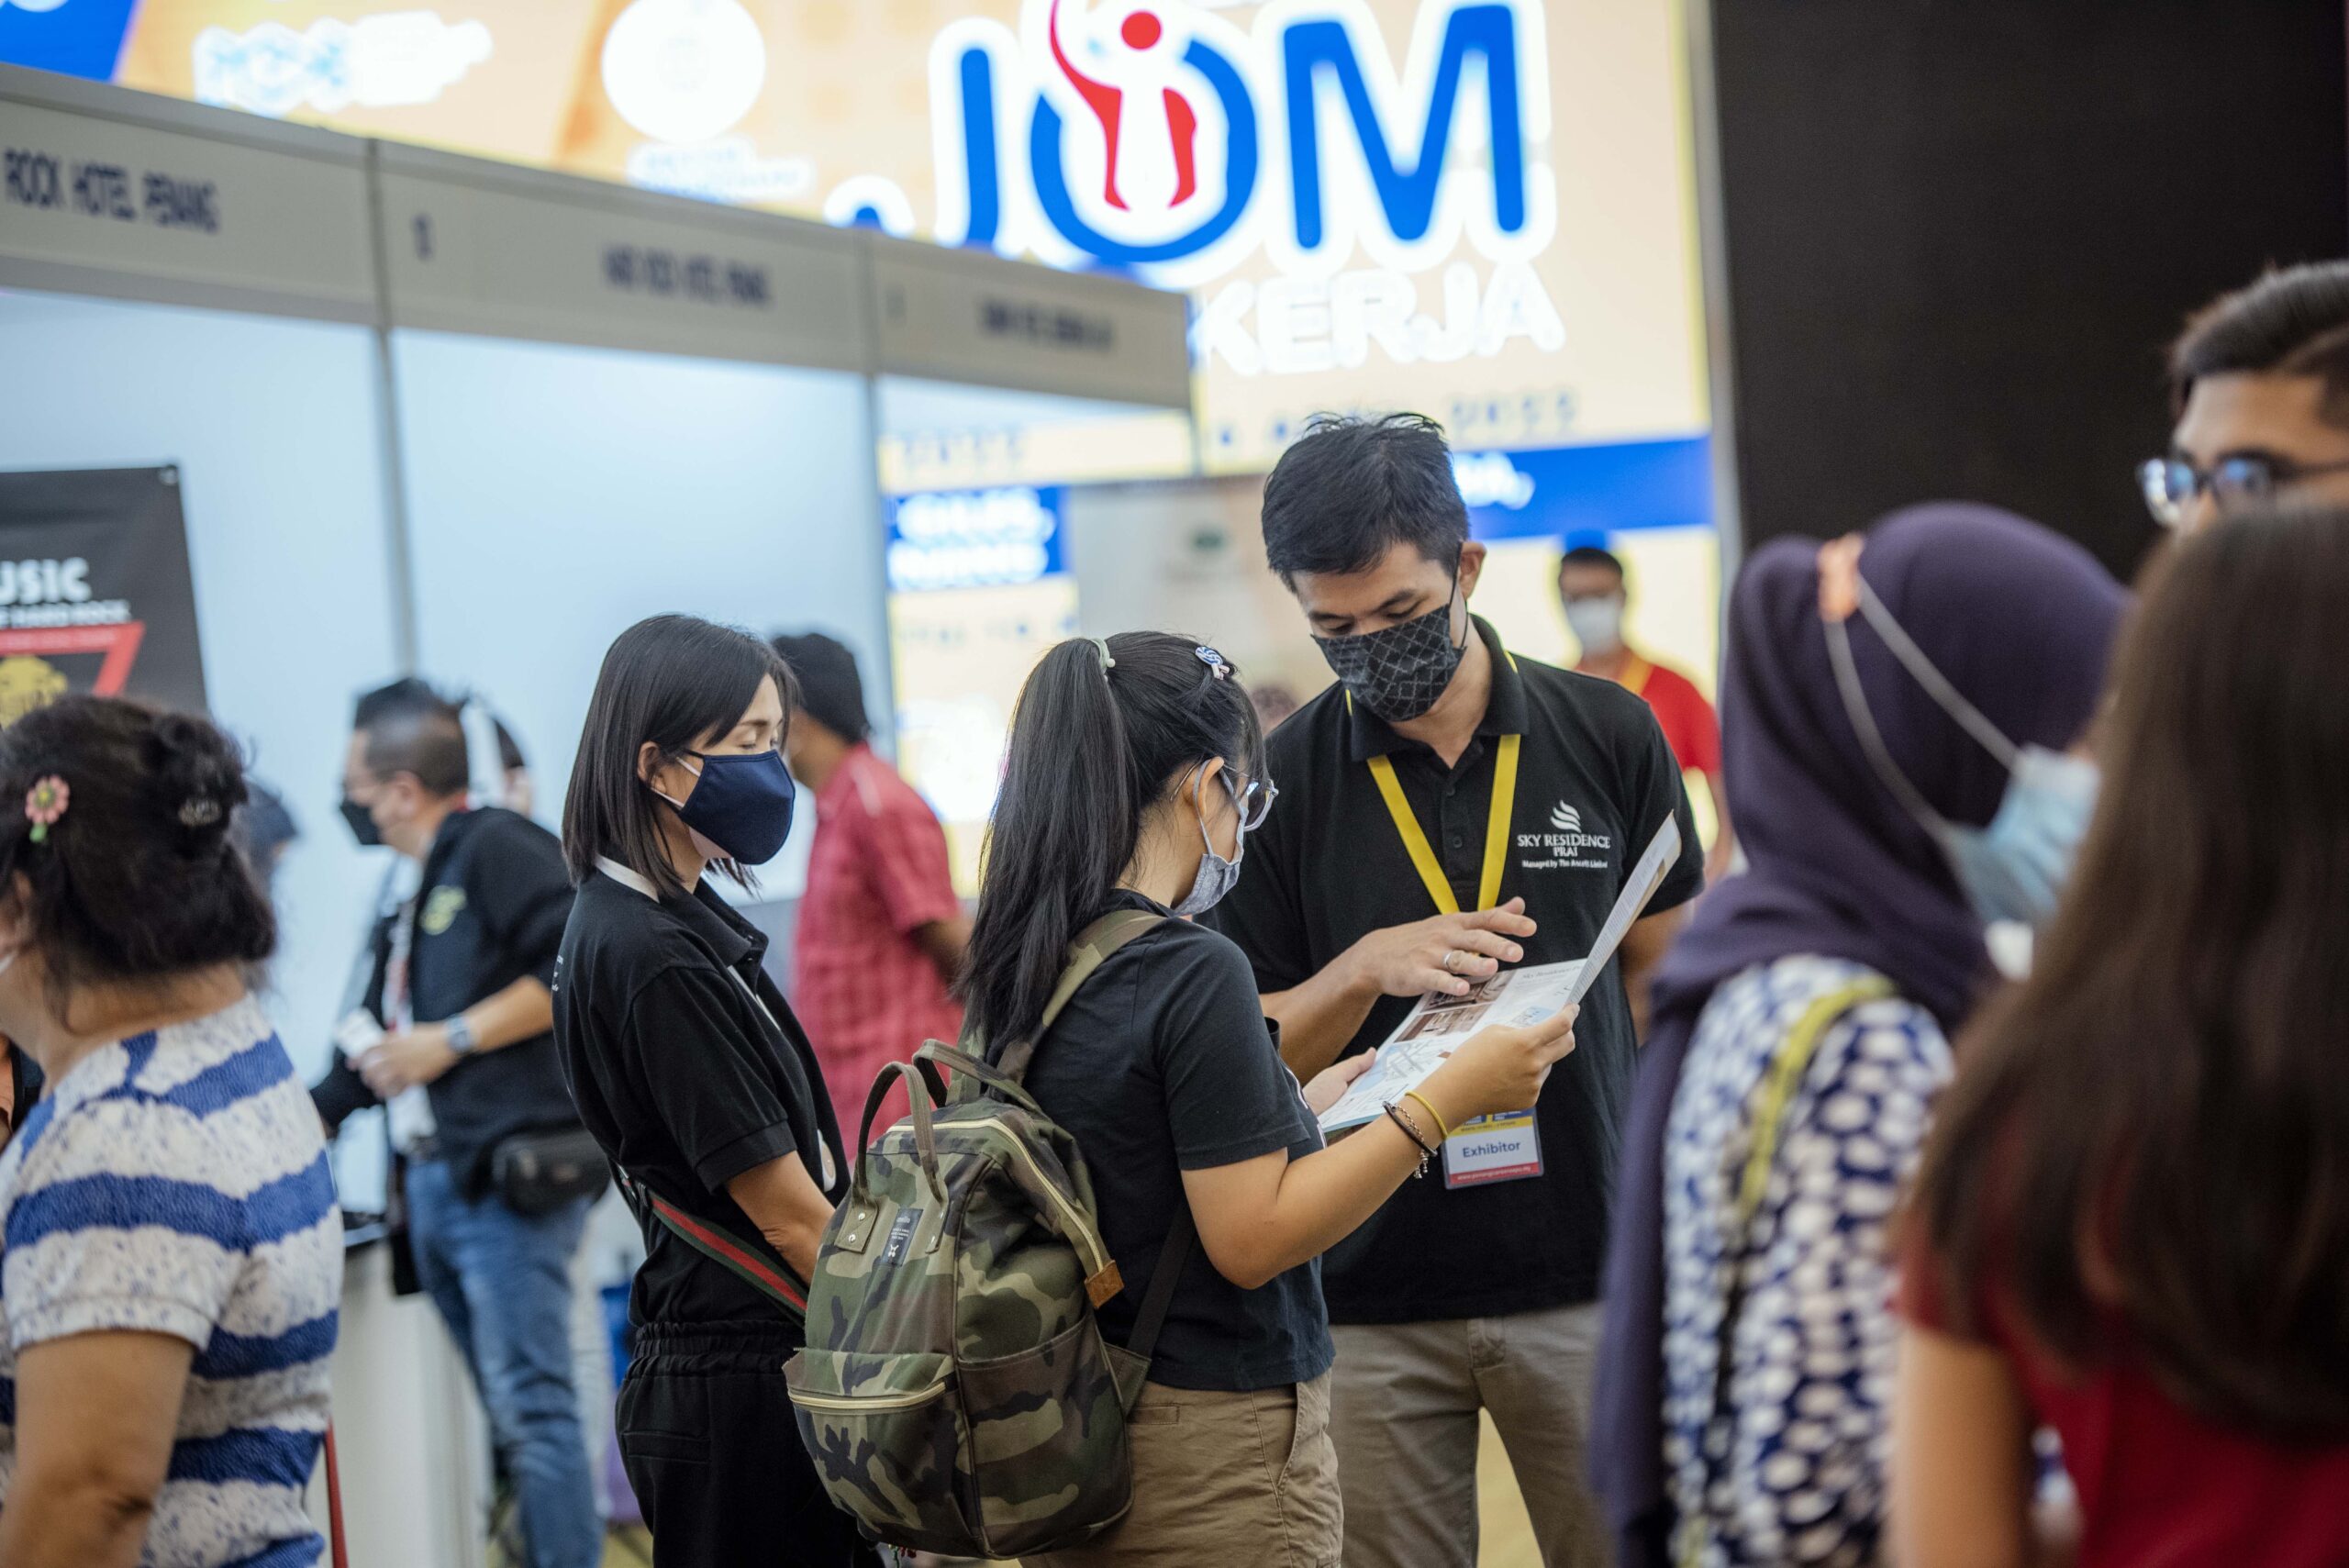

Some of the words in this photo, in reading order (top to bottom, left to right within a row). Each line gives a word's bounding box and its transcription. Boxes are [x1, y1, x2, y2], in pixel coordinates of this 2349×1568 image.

[853, 5, 1525, 261] JOM
[1193, 261, 1566, 377] KERJA
[0, 557, 92, 606] USIC
[1517, 833, 1542, 847] SKY
[1543, 833, 1611, 849] RESIDENCE
[1553, 846, 1578, 857] PRAI
[1463, 1142, 1520, 1158] Exhibitor
